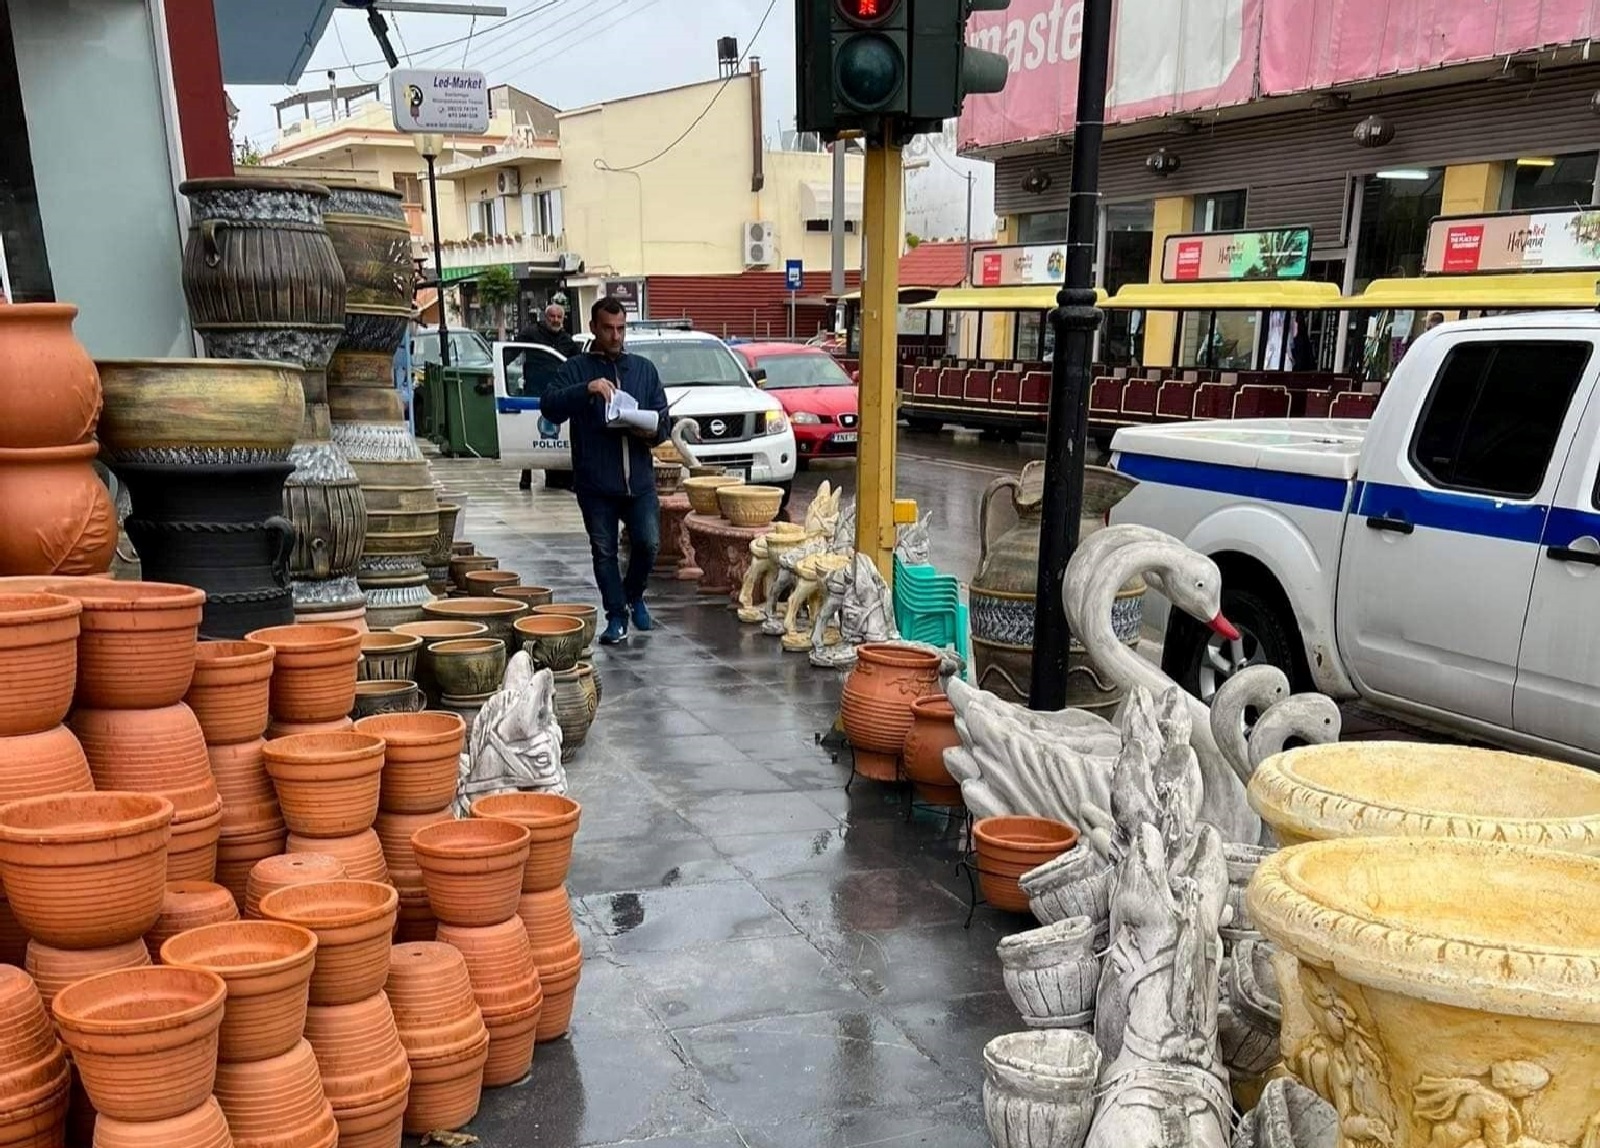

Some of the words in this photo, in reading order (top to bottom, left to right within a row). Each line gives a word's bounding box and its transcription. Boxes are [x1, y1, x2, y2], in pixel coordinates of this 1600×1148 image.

[434, 76, 482, 89] Led-Market
[1533, 223, 1547, 236] Red
[1507, 230, 1543, 253] Havana
[533, 441, 570, 449] POLICE
